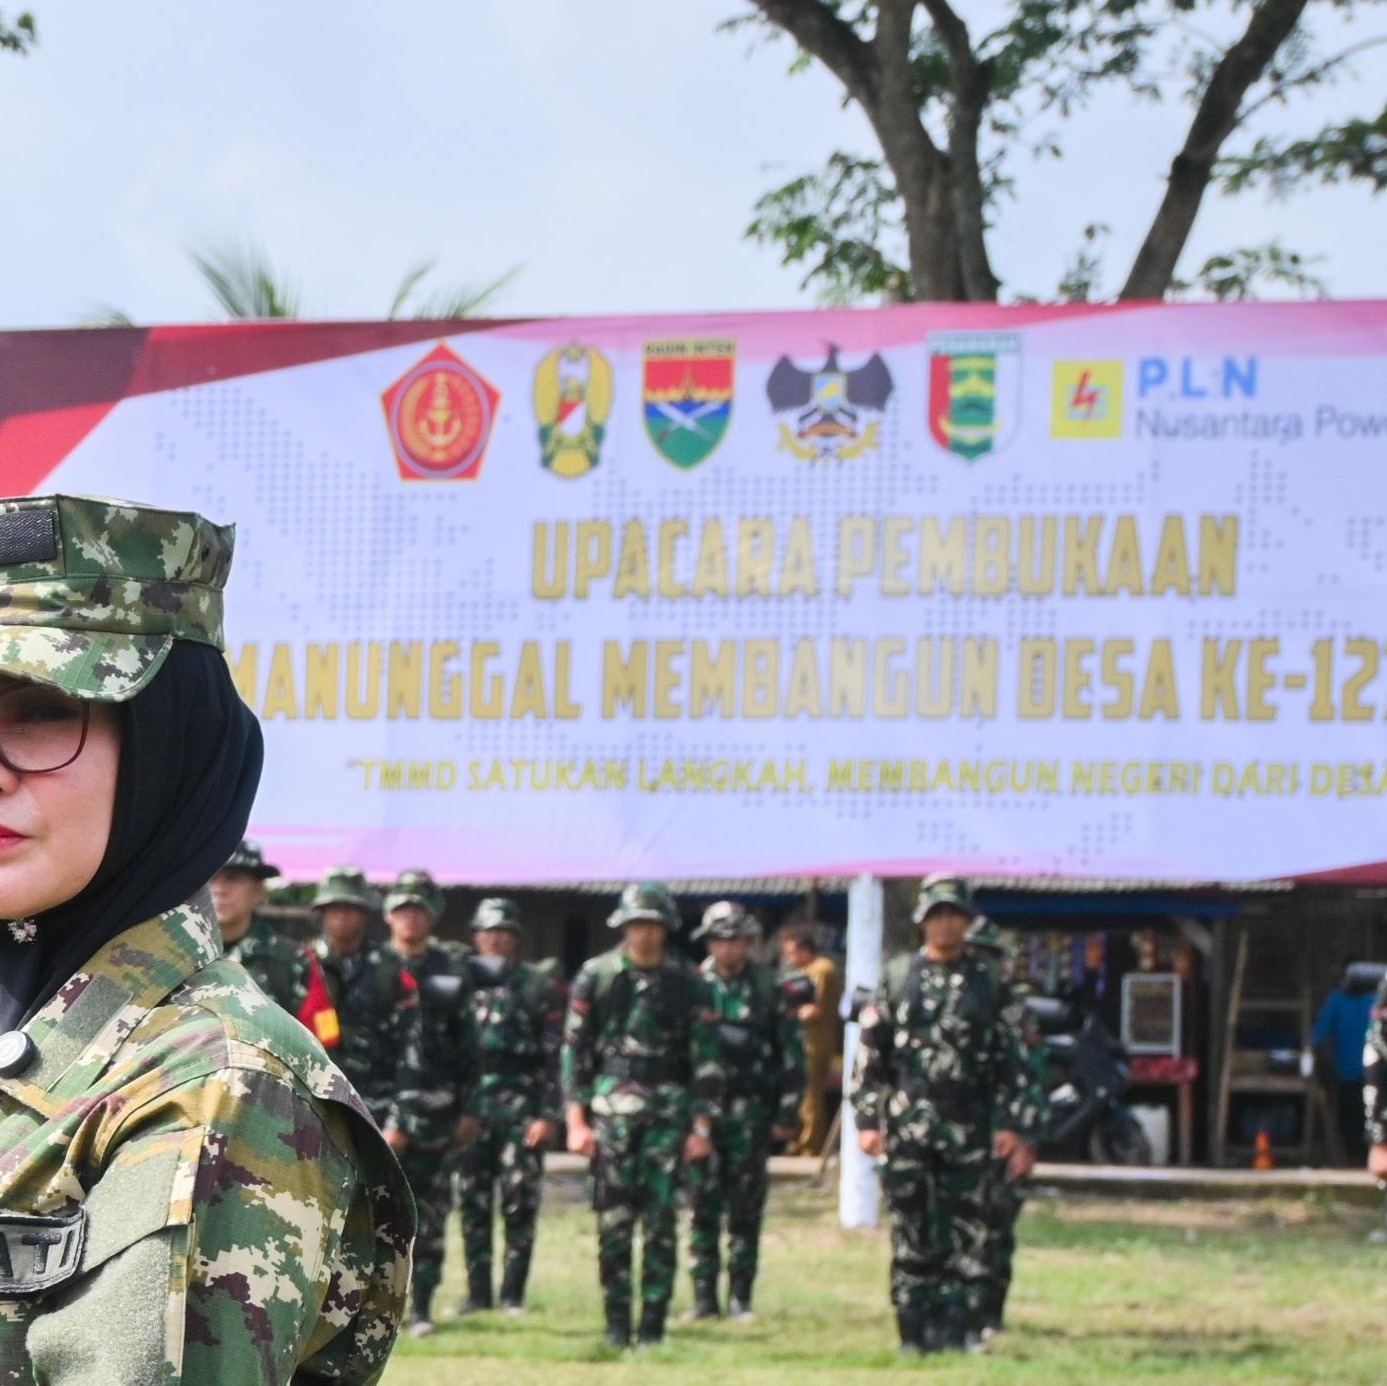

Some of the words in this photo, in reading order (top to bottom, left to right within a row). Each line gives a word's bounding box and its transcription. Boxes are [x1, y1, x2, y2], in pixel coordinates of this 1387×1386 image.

[1136, 408, 1303, 441] Nusantara
[531, 518, 818, 599] UPACARA
[837, 515, 1239, 598] PEMBUKAAN
[601, 638, 999, 720] MEMBANGUN
[1016, 637, 1180, 720] DESA
[1199, 637, 1387, 722] KE-12
[468, 758, 628, 792] SATUKAN
[827, 759, 1059, 793] MEMBANGUN
[1071, 761, 1200, 795] NEGERI
[1211, 762, 1301, 796] DARI
